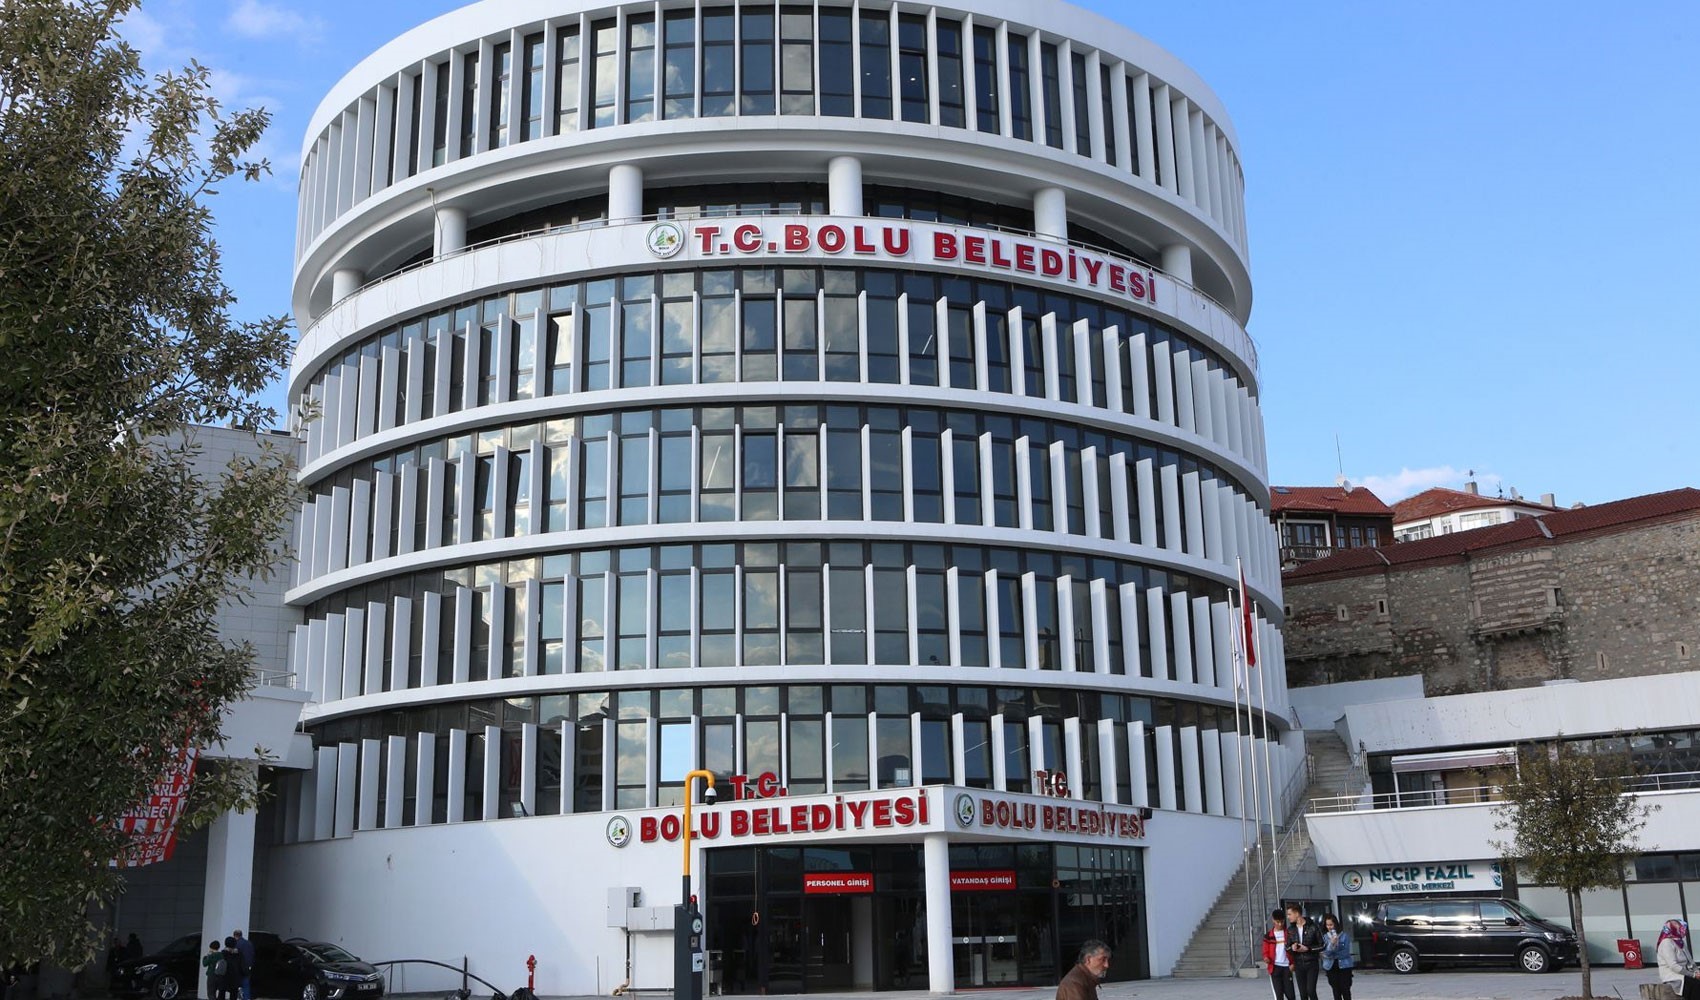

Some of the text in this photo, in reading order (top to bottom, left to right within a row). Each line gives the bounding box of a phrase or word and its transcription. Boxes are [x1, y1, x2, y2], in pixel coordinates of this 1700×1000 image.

[933, 231, 1157, 303] BELEDİYESİ
[729, 771, 788, 800] T.C.
[1036, 770, 1072, 798] T.C.
[731, 789, 930, 837] BELEDİYESİ
[982, 799, 1146, 838] BOLU BELEDİYESİ
[847, 878, 870, 888] GİRİŞİ
[951, 875, 1012, 885] VATANDAŞ GİRİŞİ
[1369, 864, 1474, 883] NECİP FAZIL
[1391, 880, 1455, 892] KÜLTÜR MERKEZİ
